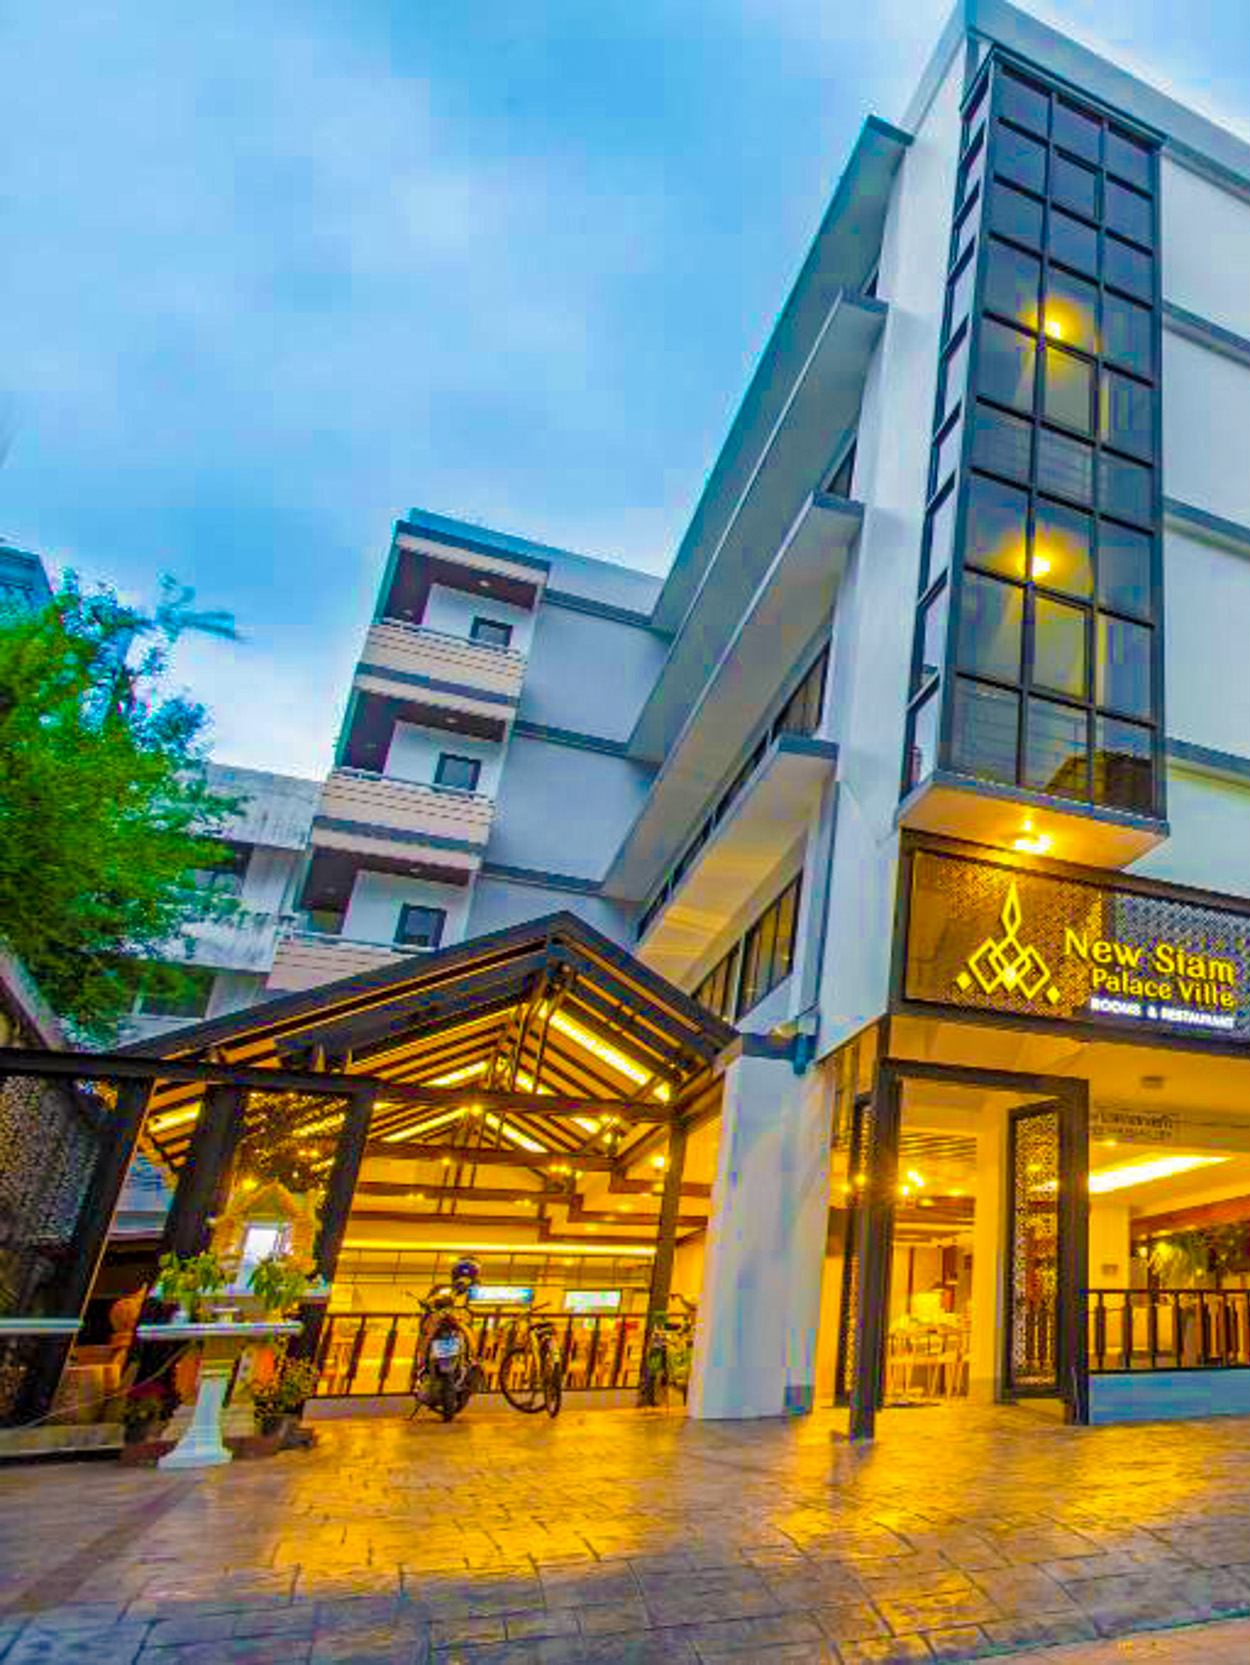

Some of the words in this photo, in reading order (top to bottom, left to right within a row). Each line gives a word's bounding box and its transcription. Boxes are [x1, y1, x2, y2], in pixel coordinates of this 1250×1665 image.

[1064, 927, 1141, 967] New
[1155, 944, 1236, 987] Siam
[1093, 968, 1172, 1000] Palace
[1177, 980, 1234, 1008] Ville
[1090, 997, 1141, 1016] ROOMS
[1161, 1007, 1234, 1029] RESTAURANT
